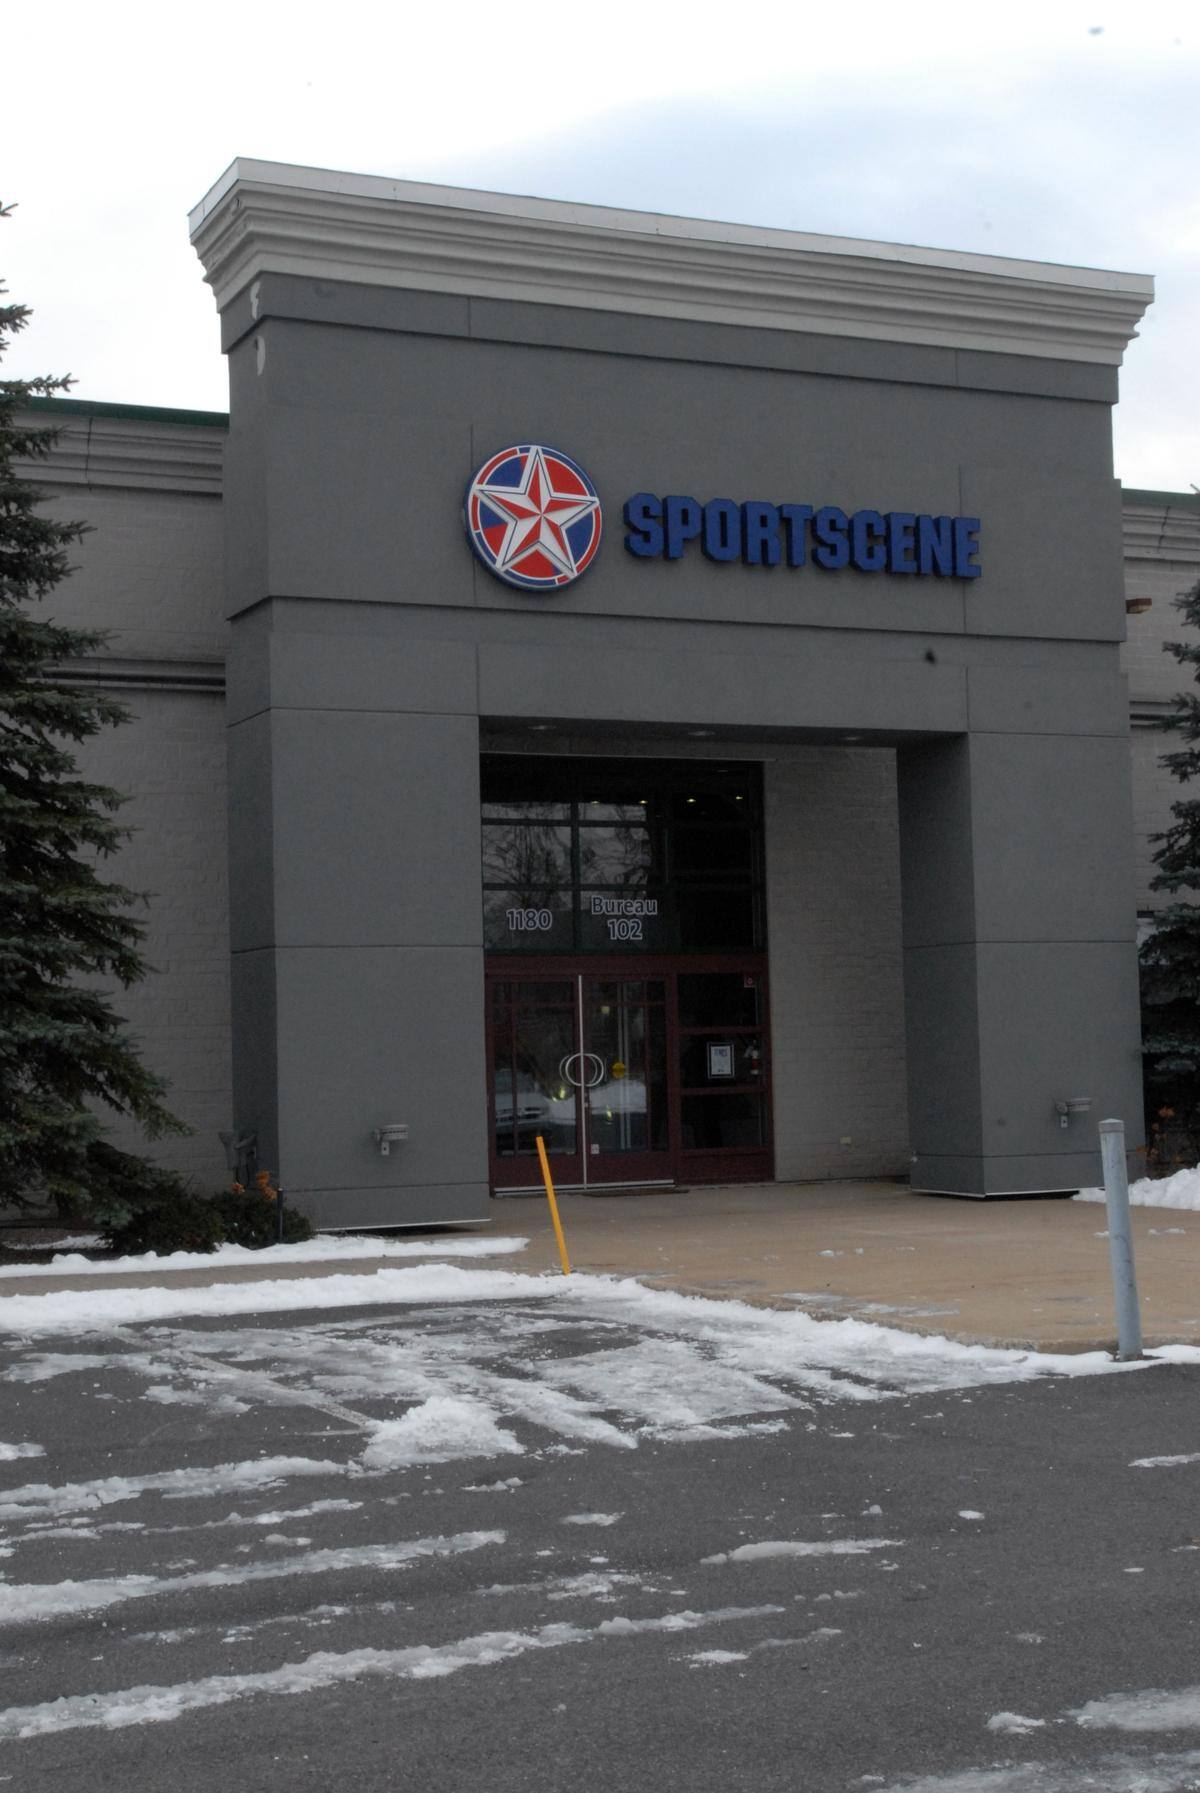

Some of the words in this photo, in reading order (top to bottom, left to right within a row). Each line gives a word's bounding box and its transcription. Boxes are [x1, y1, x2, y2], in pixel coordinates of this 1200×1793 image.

[623, 492, 982, 579] SPORTSCENE
[591, 895, 658, 915] Bureau
[506, 908, 553, 931] 1180
[608, 919, 643, 940] 102
